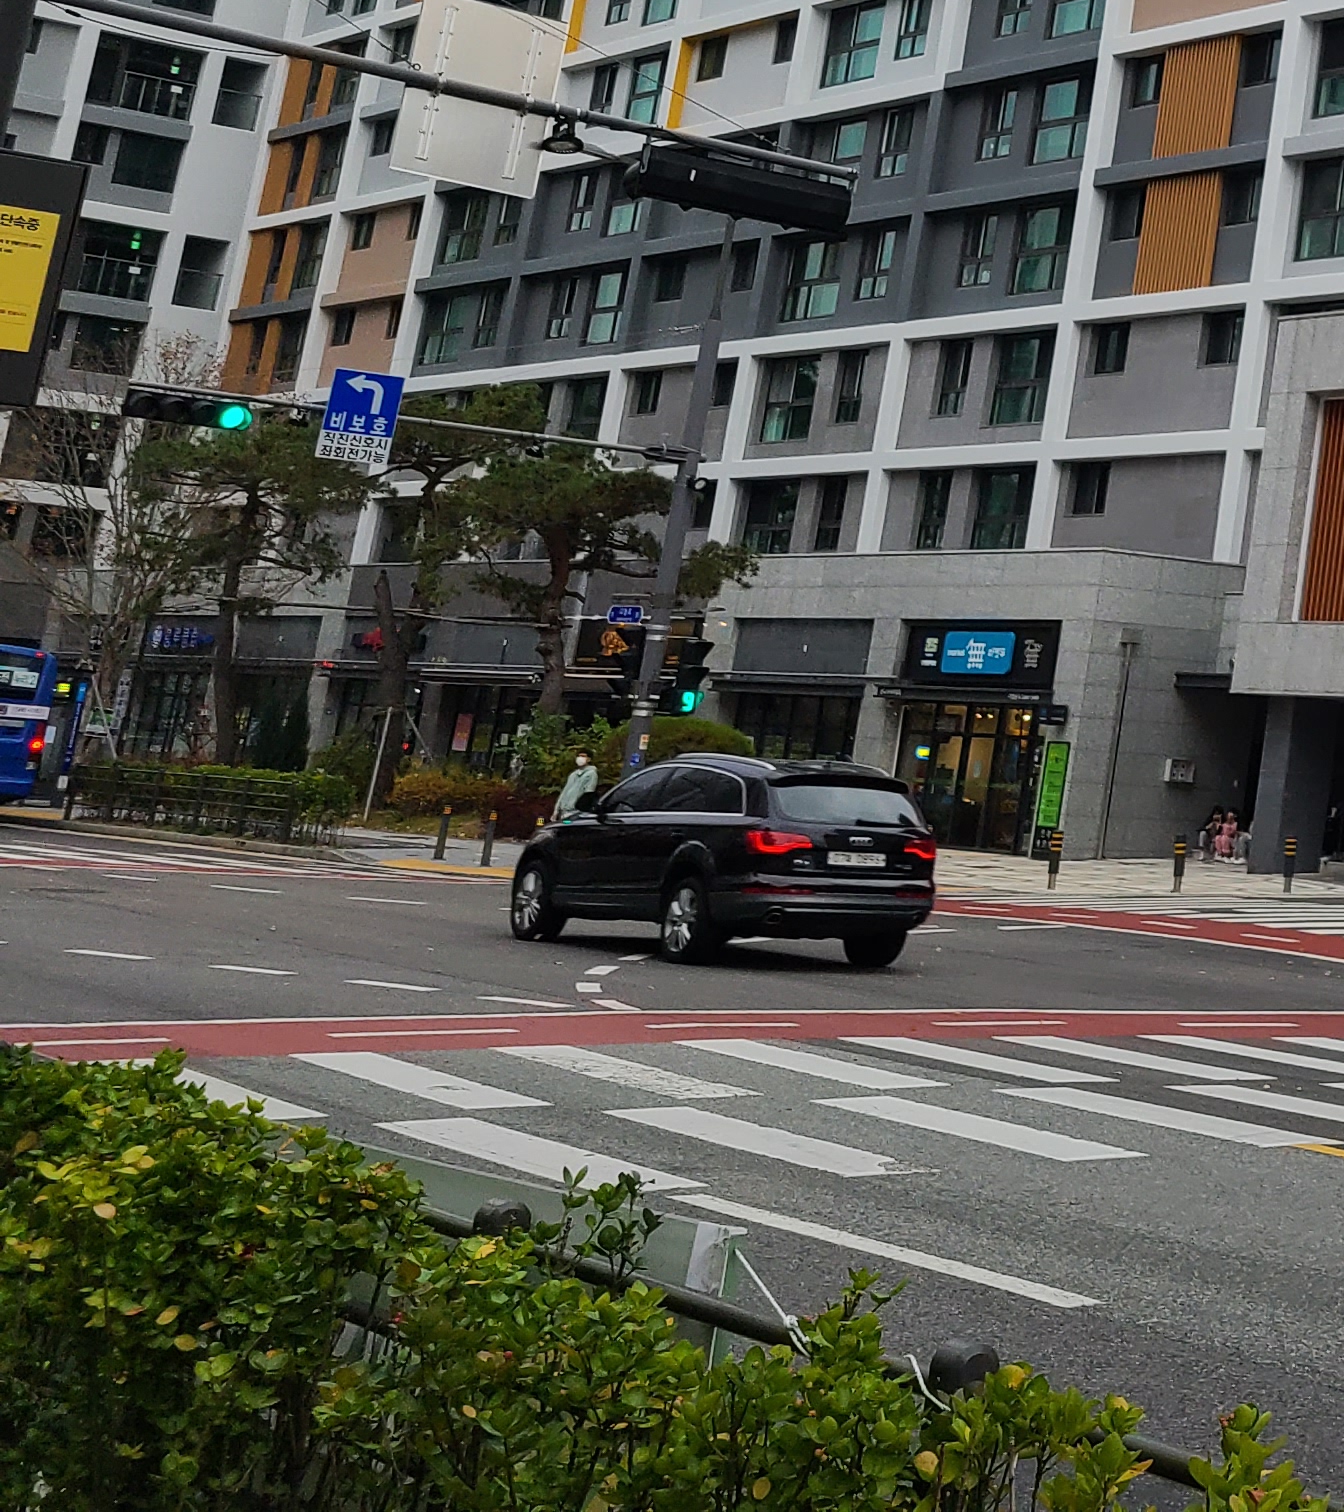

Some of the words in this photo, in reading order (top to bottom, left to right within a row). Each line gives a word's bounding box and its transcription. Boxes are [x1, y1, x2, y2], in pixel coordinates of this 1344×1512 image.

[329, 411, 388, 435] 비보호
[323, 431, 388, 450] 직진신호시
[319, 444, 385, 463] 좌회전가능
